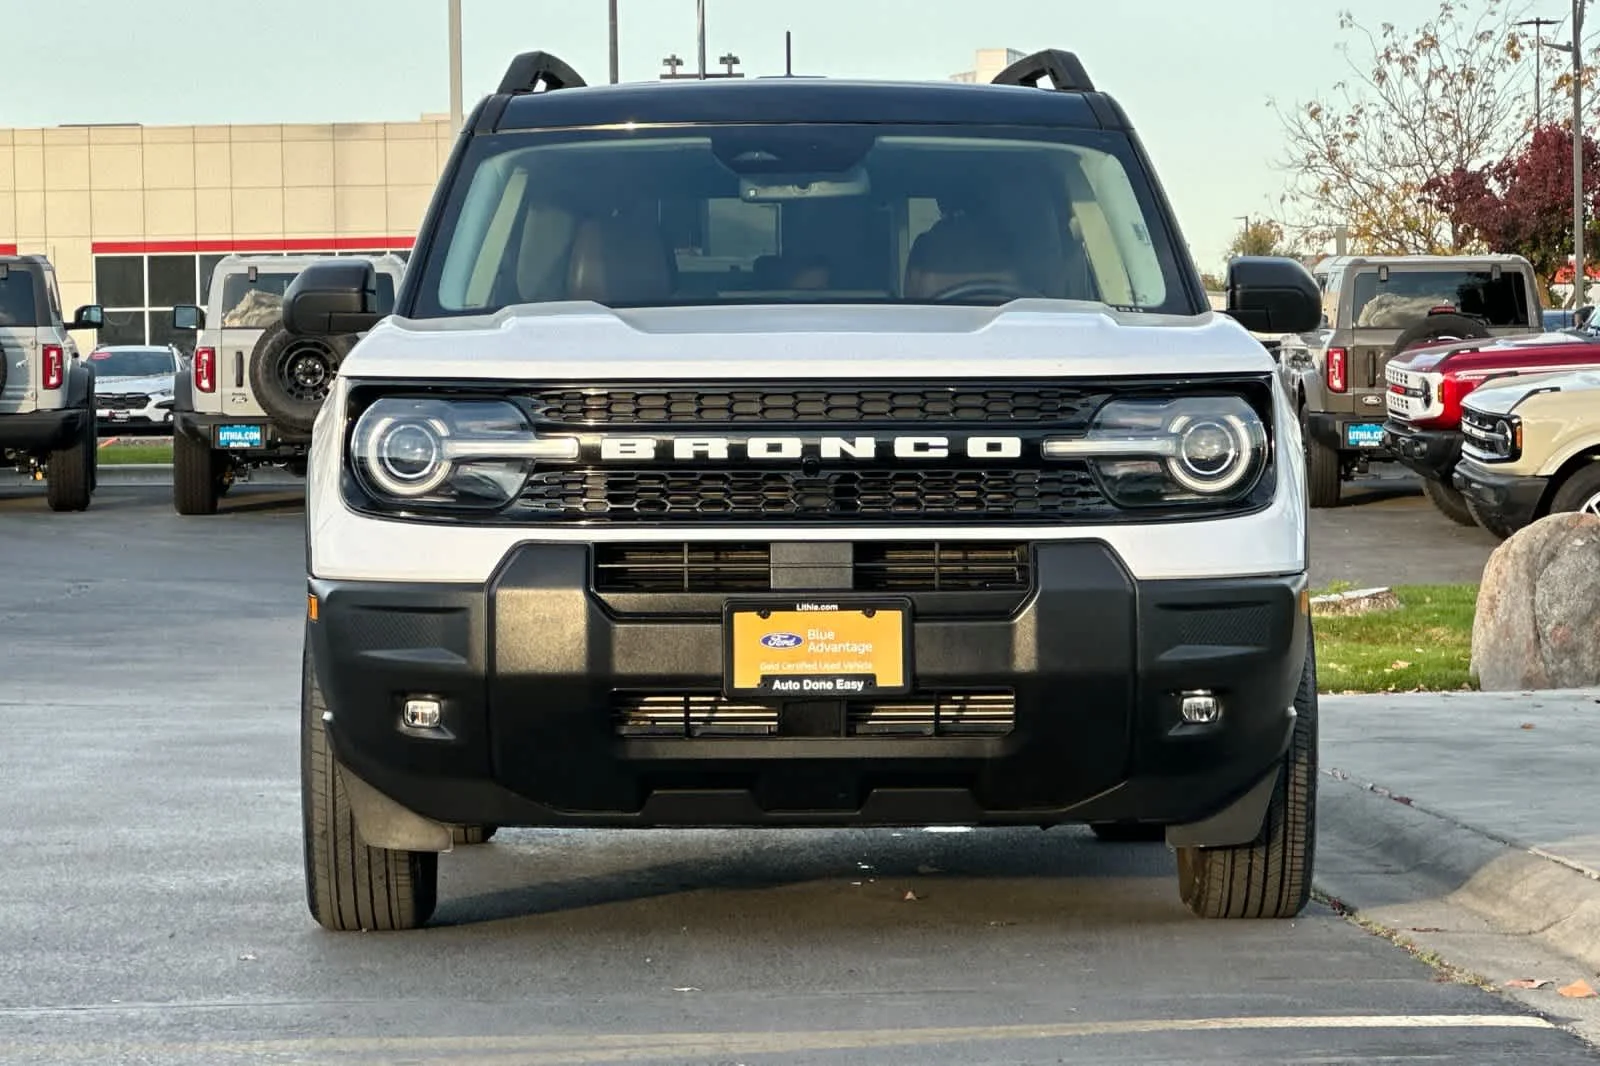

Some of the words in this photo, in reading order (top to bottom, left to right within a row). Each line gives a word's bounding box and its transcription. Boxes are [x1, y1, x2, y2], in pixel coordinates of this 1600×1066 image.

[219, 431, 261, 441] LITHIA.COM
[600, 436, 1022, 459] BRONCO
[796, 603, 838, 611] Lithia.com
[766, 634, 797, 647] Ford
[807, 629, 835, 640] Blue
[807, 642, 873, 655] Advantage
[760, 661, 780, 671] Gold
[782, 661, 818, 671] Certified
[820, 661, 841, 671] Used
[842, 661, 873, 671] Vehicle
[772, 680, 800, 691] Auto
[803, 680, 833, 690] Done
[836, 679, 864, 692] Easy
